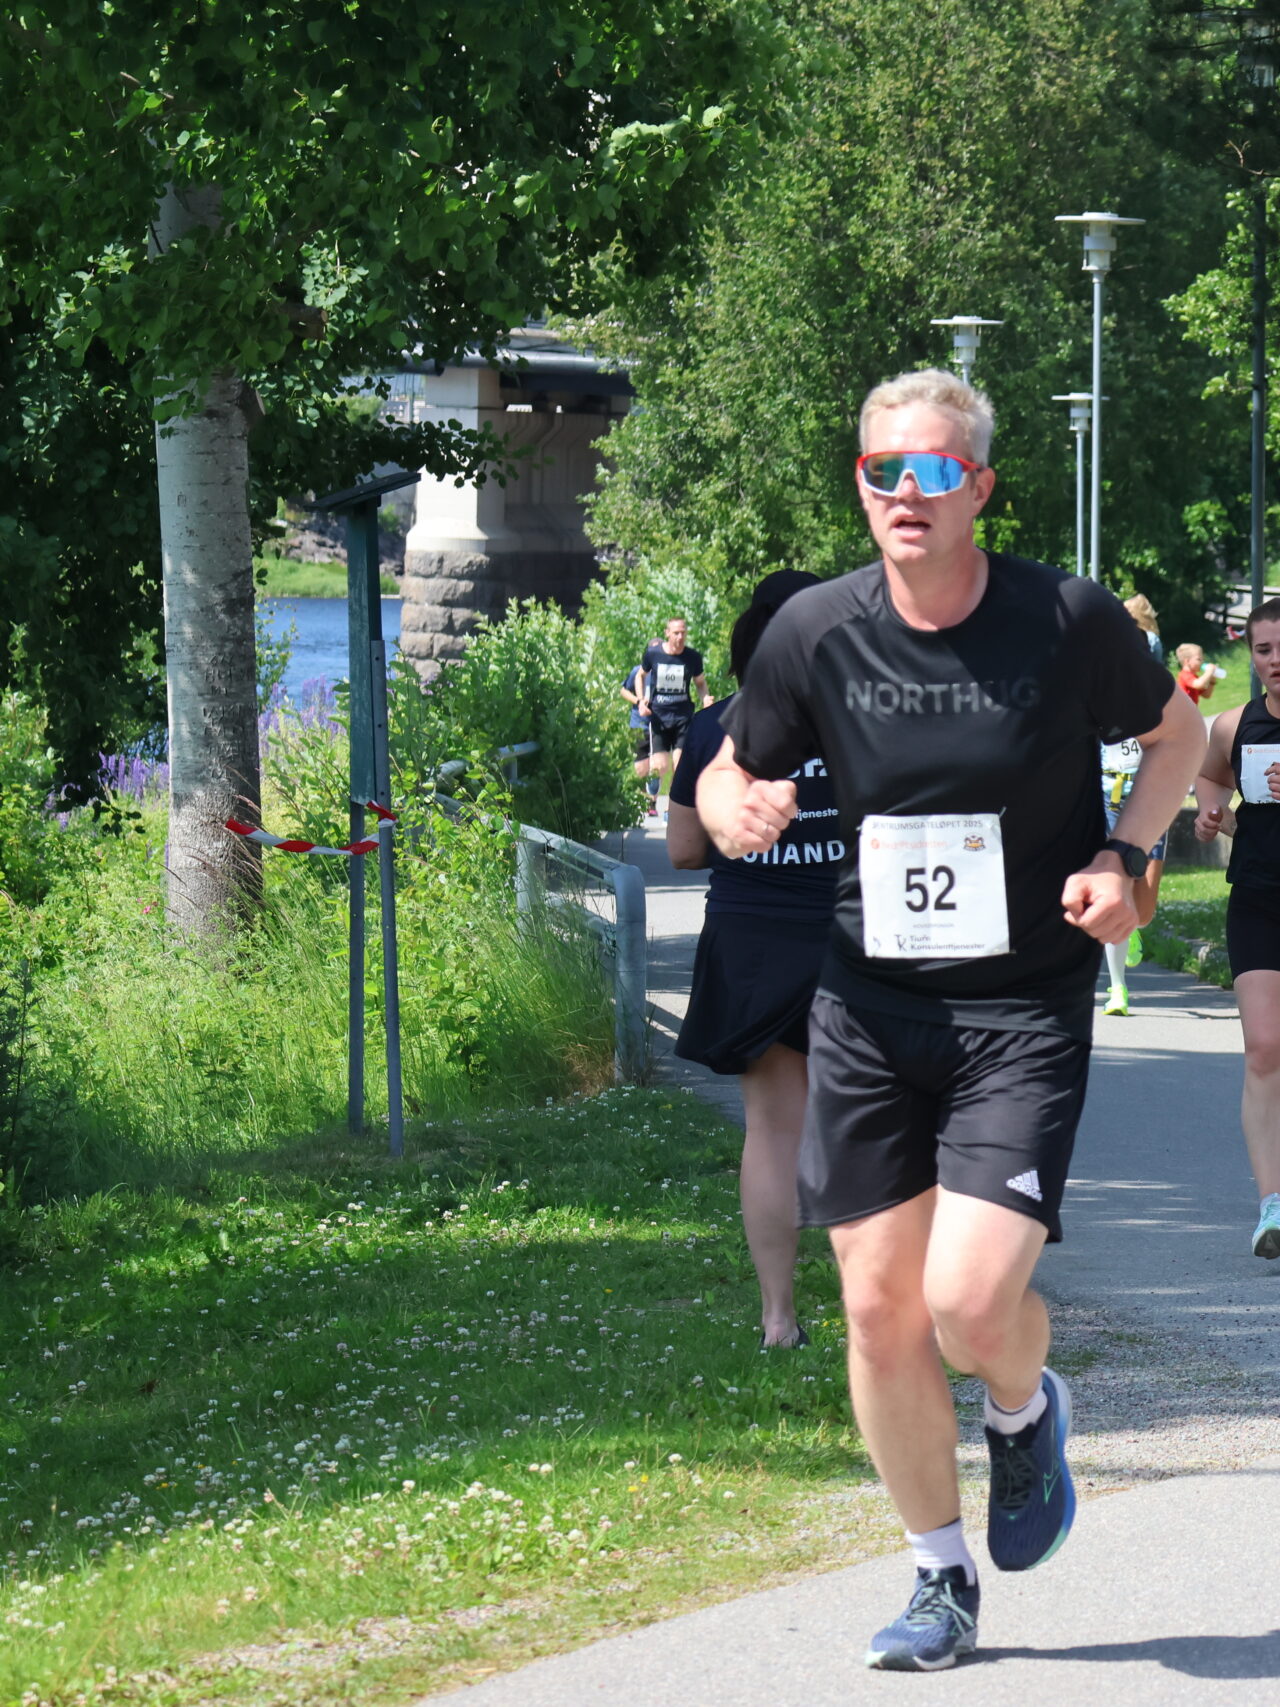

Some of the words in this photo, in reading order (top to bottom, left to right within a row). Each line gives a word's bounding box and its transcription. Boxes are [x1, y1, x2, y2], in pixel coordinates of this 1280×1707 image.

[665, 674, 676, 682] 60
[846, 678, 1041, 714] NORTHUG
[1121, 740, 1139, 756] 54
[905, 865, 957, 913] 52
